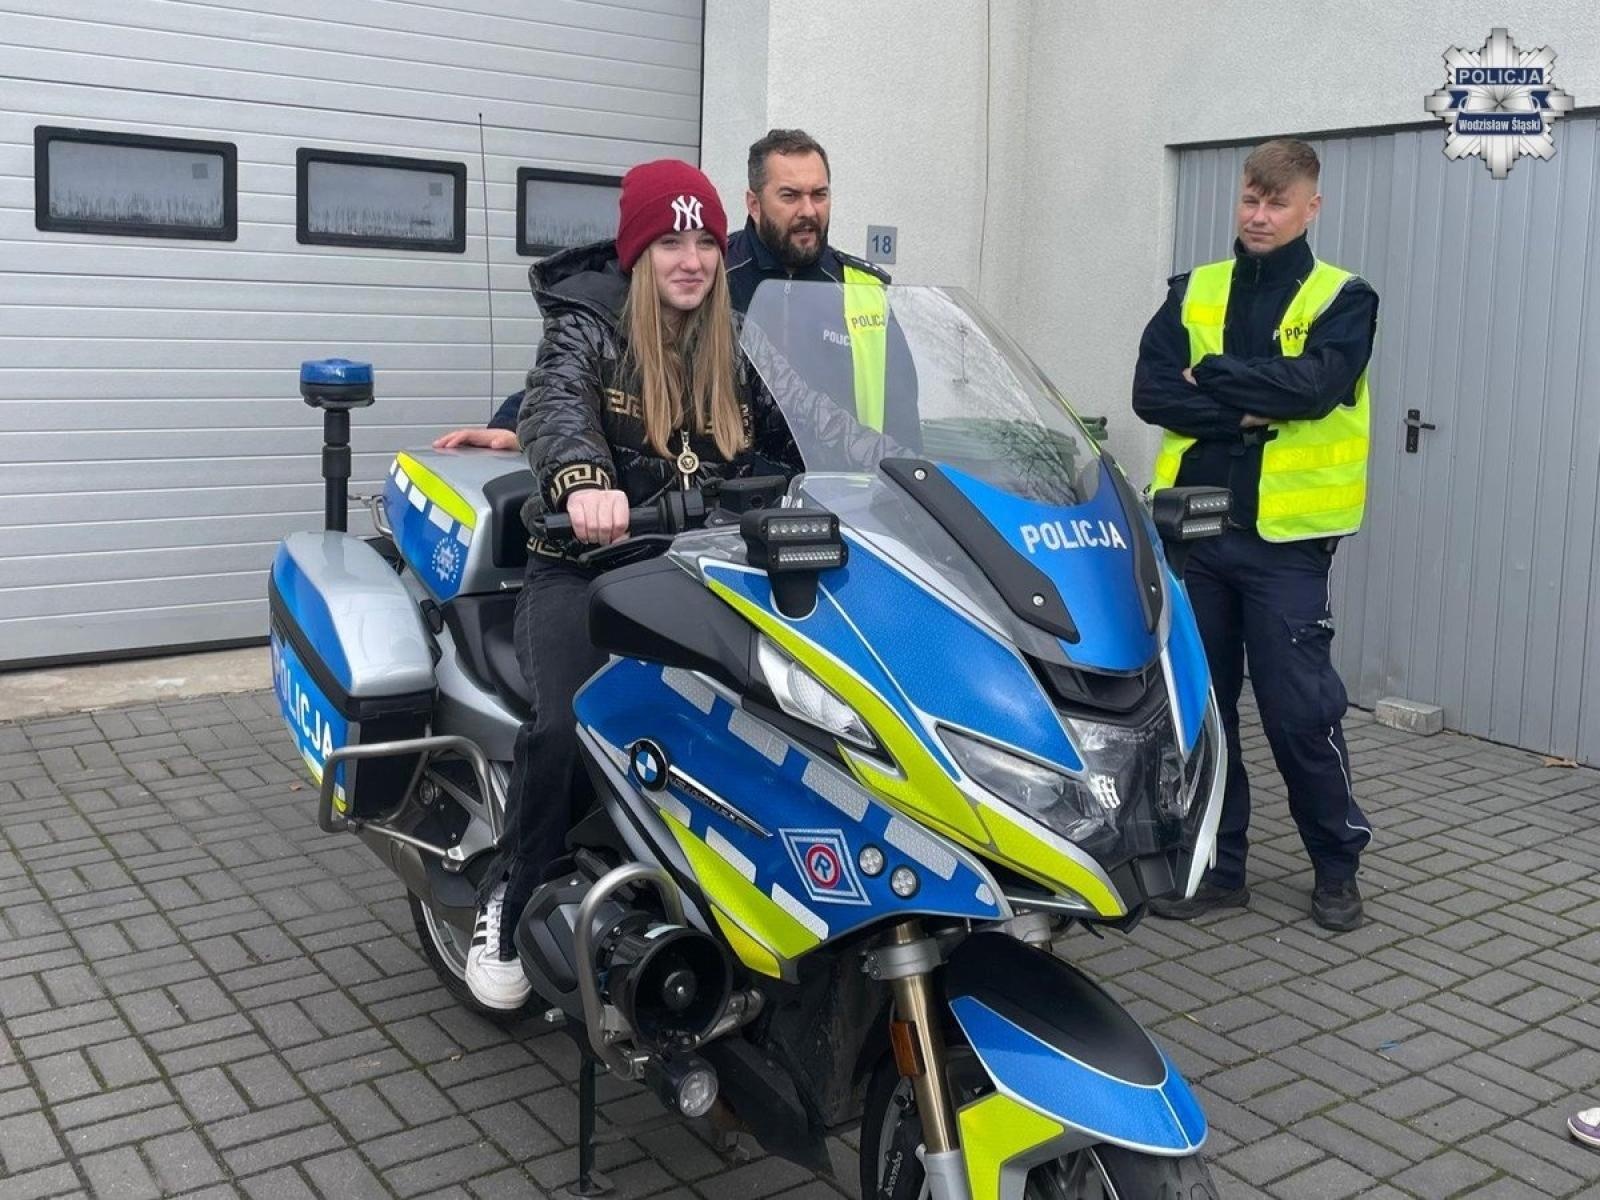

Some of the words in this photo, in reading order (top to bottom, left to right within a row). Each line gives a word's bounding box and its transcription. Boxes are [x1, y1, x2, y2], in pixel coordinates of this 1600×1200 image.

[871, 235, 892, 254] 18
[851, 314, 885, 329] POLICJ
[823, 329, 850, 346] POLIC
[1020, 519, 1127, 554] POLICJA
